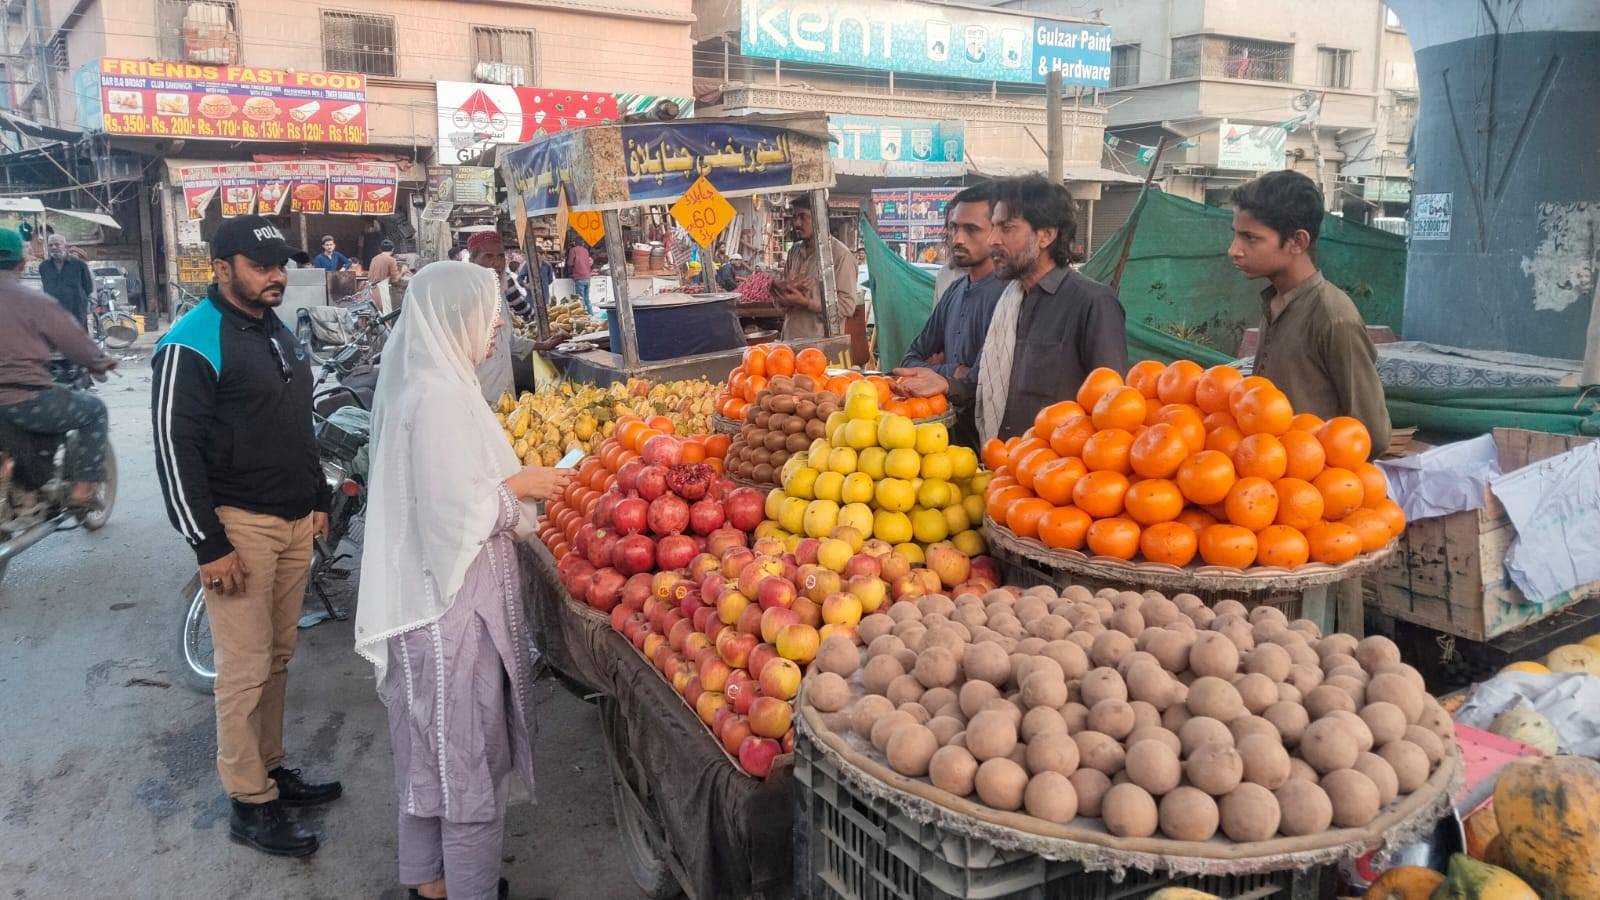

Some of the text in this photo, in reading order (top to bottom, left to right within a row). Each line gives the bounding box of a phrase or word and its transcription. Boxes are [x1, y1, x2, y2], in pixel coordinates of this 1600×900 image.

[1037, 26, 1111, 52] Gulzar Paint
[103, 60, 219, 80] FRIENDS
[227, 67, 288, 85] FAST
[295, 72, 361, 89] FOOD
[1038, 55, 1110, 81] & Hardware
[104, 114, 151, 132] Rs. 350/-
[152, 116, 196, 135] Rs. 200/-
[198, 118, 241, 137] Rs. 170/-
[242, 120, 284, 139] Rs. 130/-
[693, 207, 716, 229] 60
